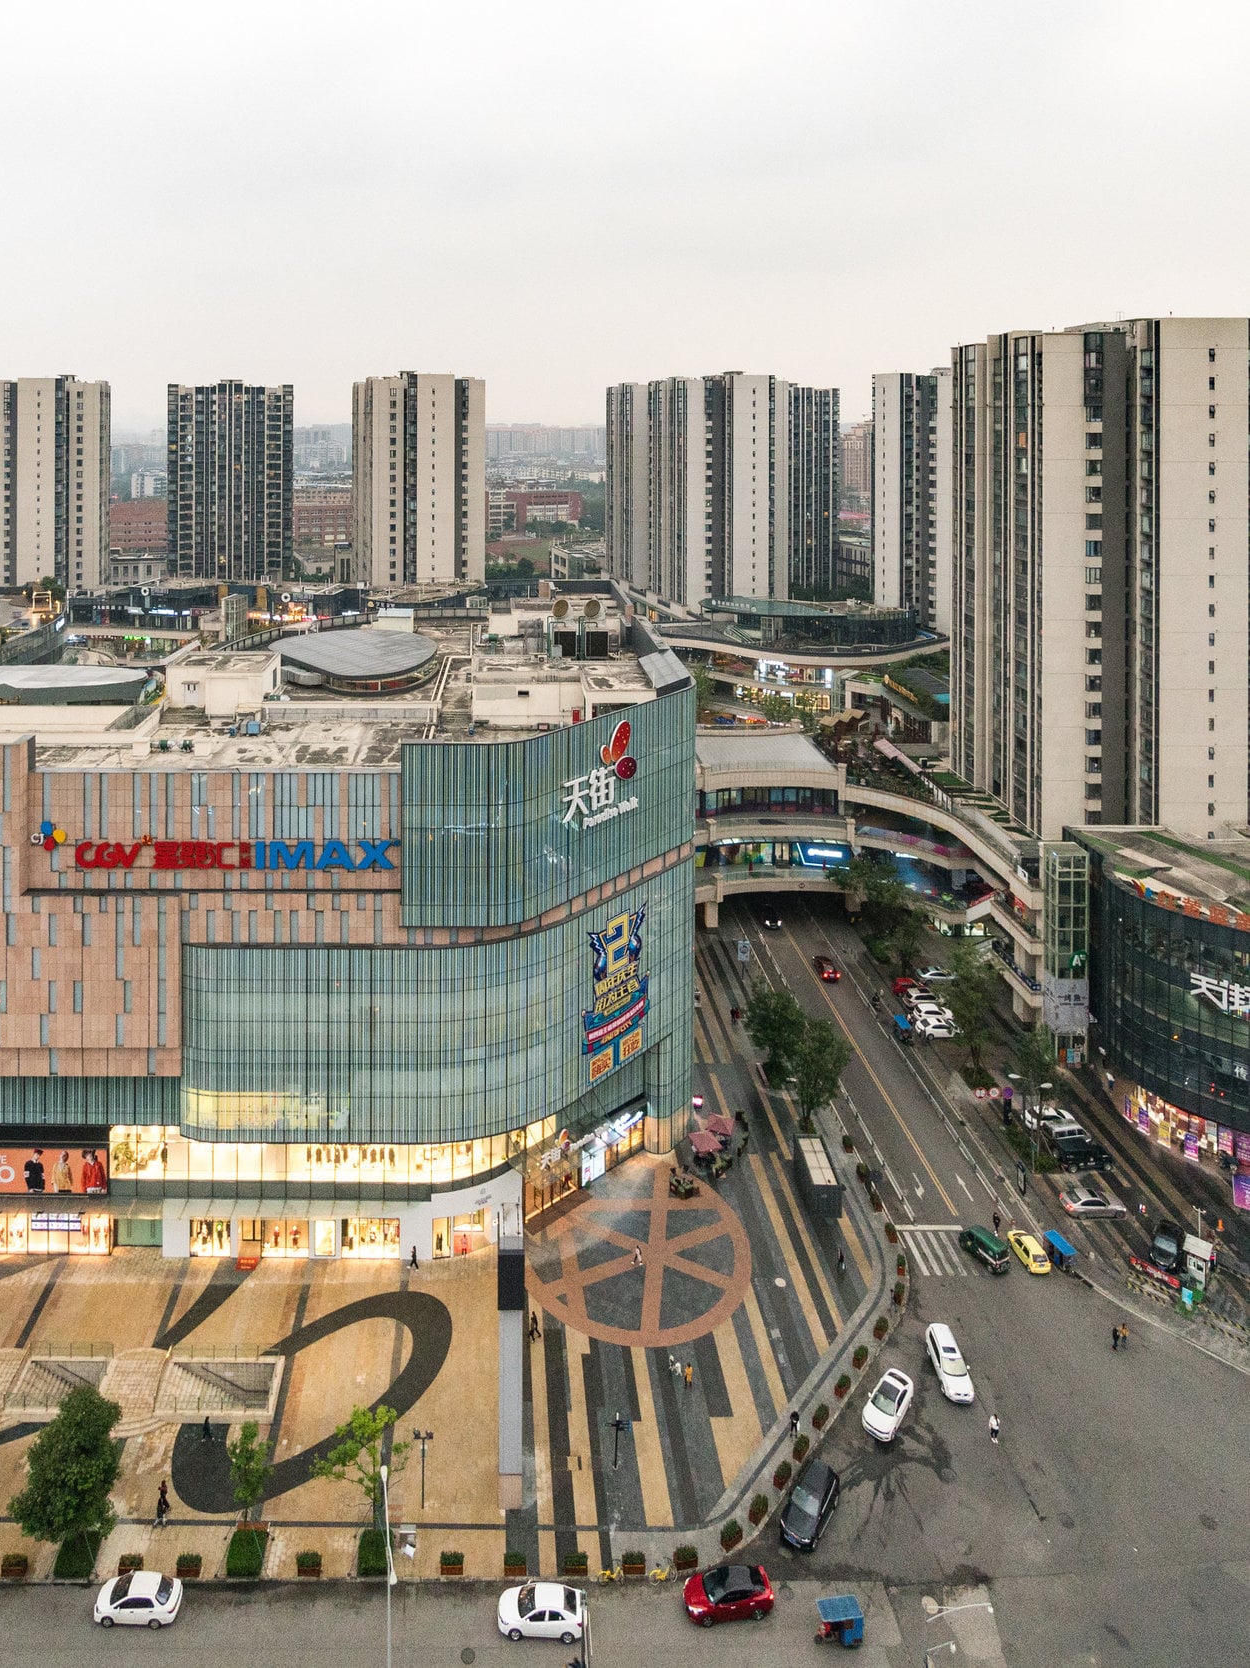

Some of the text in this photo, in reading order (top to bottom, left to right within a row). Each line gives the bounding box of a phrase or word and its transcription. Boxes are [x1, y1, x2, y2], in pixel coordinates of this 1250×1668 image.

[562, 765, 617, 824] 天街
[30, 832, 45, 846] CJ
[74, 840, 142, 869] CGV
[254, 839, 396, 871] IMAX
[606, 911, 630, 976] 2
